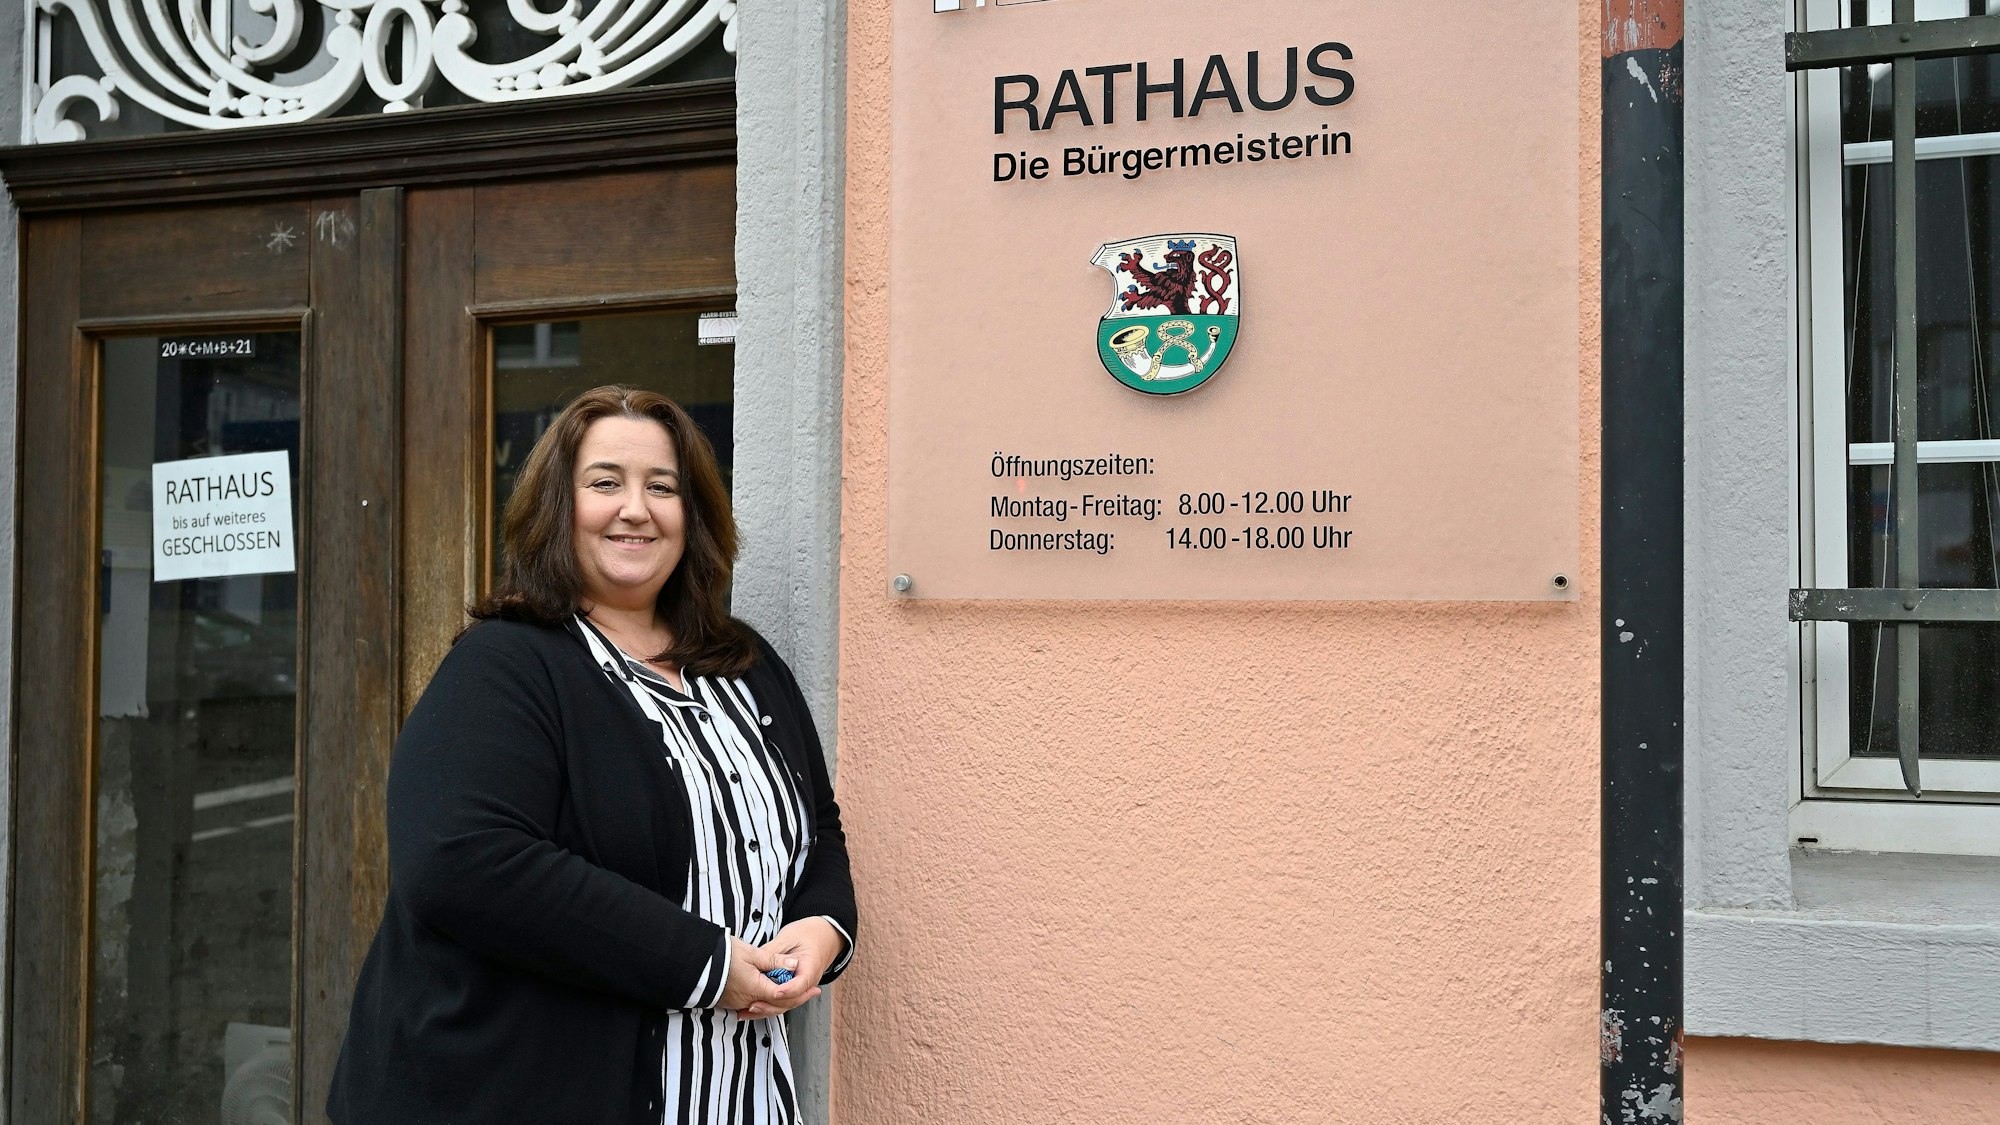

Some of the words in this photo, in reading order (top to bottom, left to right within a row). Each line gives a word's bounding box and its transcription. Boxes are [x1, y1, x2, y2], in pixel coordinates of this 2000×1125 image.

[994, 42, 1355, 135] RATHAUS
[993, 152, 1050, 182] Die
[1063, 123, 1352, 181] Bürgermeisterin
[991, 454, 1154, 481] Öffnungszeiten:
[166, 471, 274, 505] RATHAUS
[1313, 490, 1352, 513] Uhr
[172, 516, 188, 530] bis
[191, 513, 211, 528] auf
[213, 511, 266, 526] weiteres
[162, 530, 281, 557] GESCHLOSSEN
[990, 529, 1115, 555] Donnerstag:
[1313, 525, 1353, 549] Uhr
